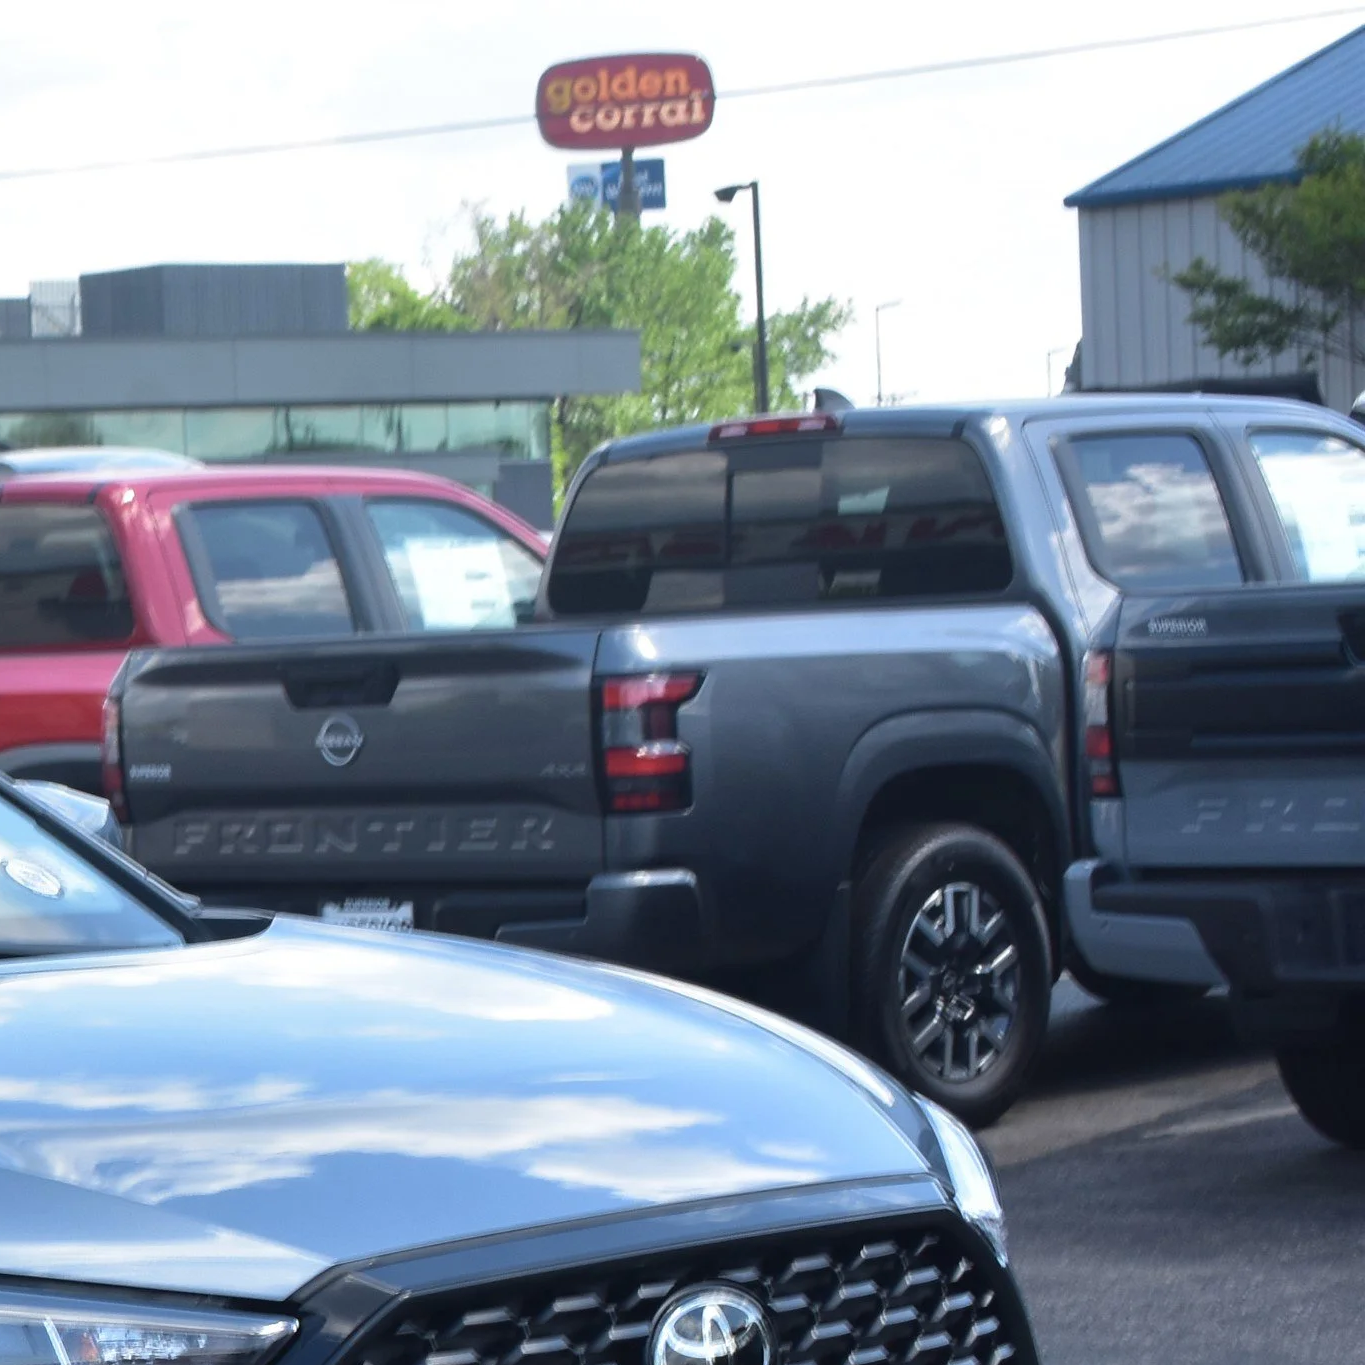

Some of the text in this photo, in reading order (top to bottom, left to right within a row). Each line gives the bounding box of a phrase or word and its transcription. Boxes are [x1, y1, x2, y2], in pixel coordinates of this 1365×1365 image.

[546, 65, 690, 114] golden
[570, 88, 706, 134] corral
[173, 816, 555, 855] FRONTIER
